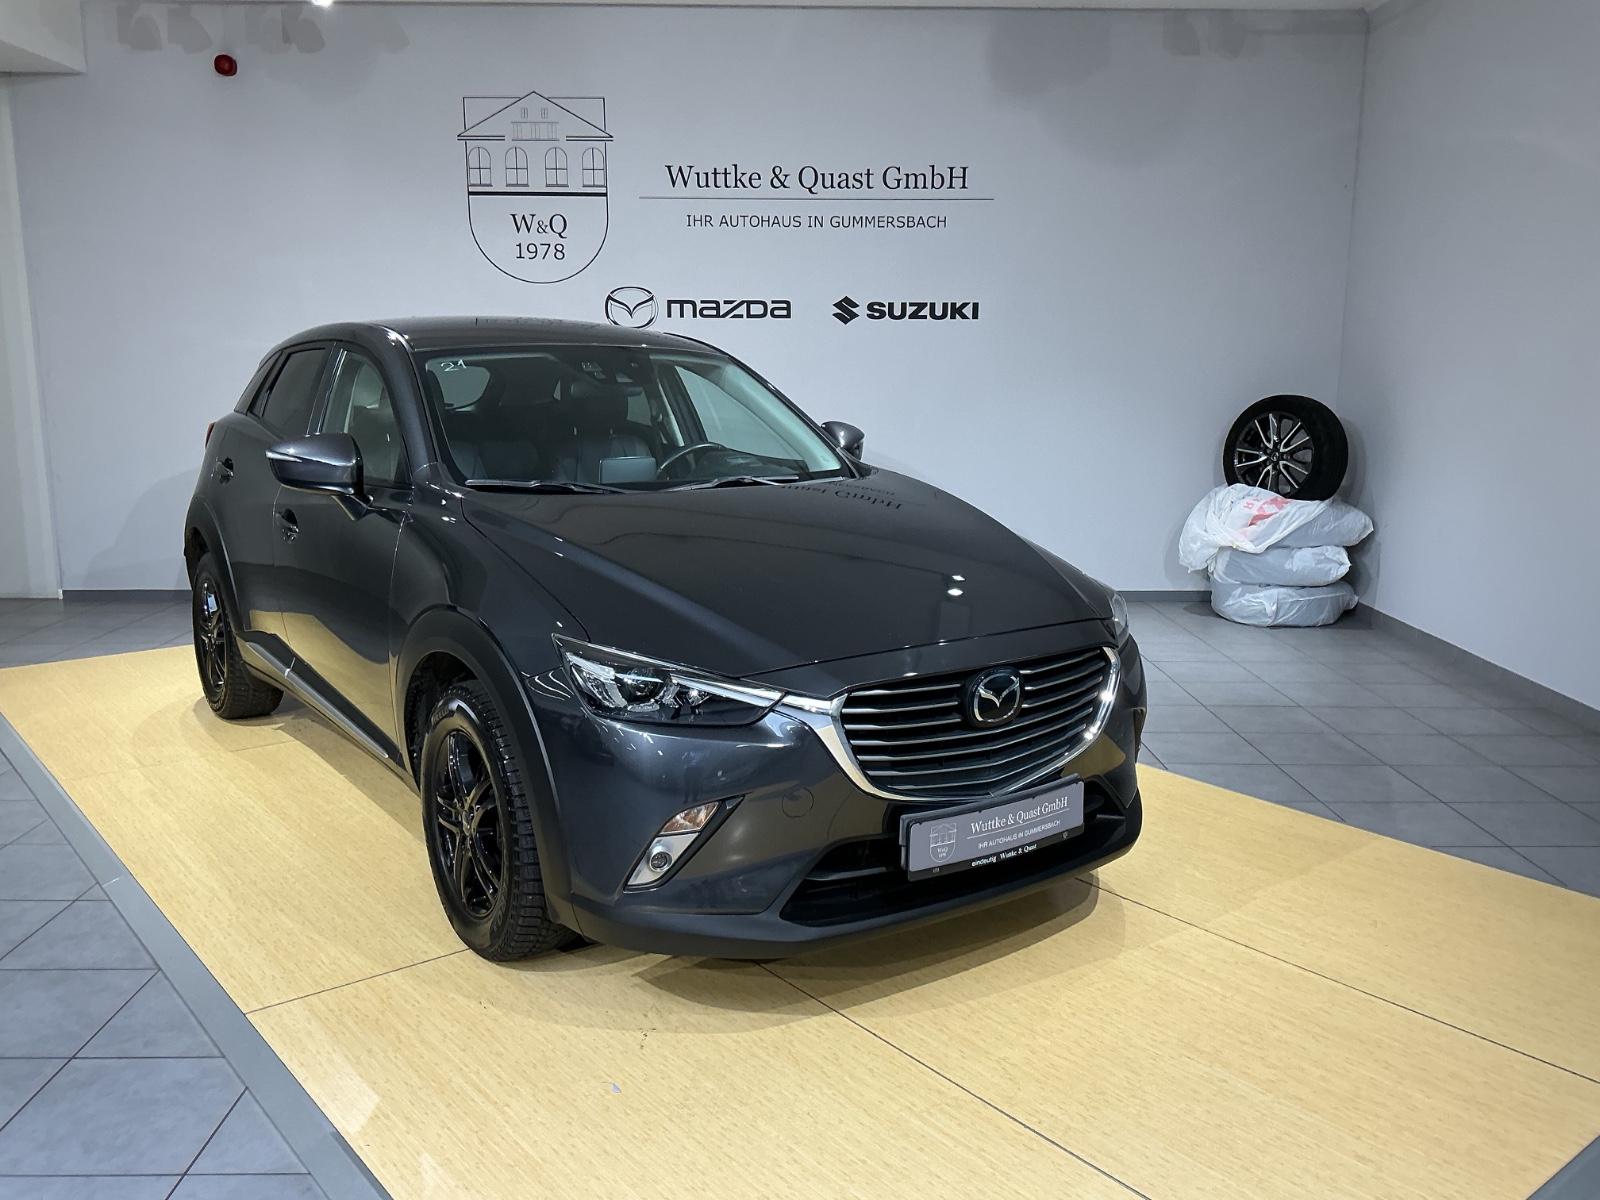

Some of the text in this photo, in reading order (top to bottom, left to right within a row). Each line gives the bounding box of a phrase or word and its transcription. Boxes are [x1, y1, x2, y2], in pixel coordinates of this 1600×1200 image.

[665, 164, 968, 195] Wuttke & Quast GmbH
[510, 213, 567, 239] W&Q
[687, 215, 947, 228] IHR AUTOHAUS IN GUMMERSBACH
[516, 242, 565, 260] 1978
[866, 302, 979, 320] SUZUKI
[971, 796, 1068, 834] Wuttke & Quast GmbH
